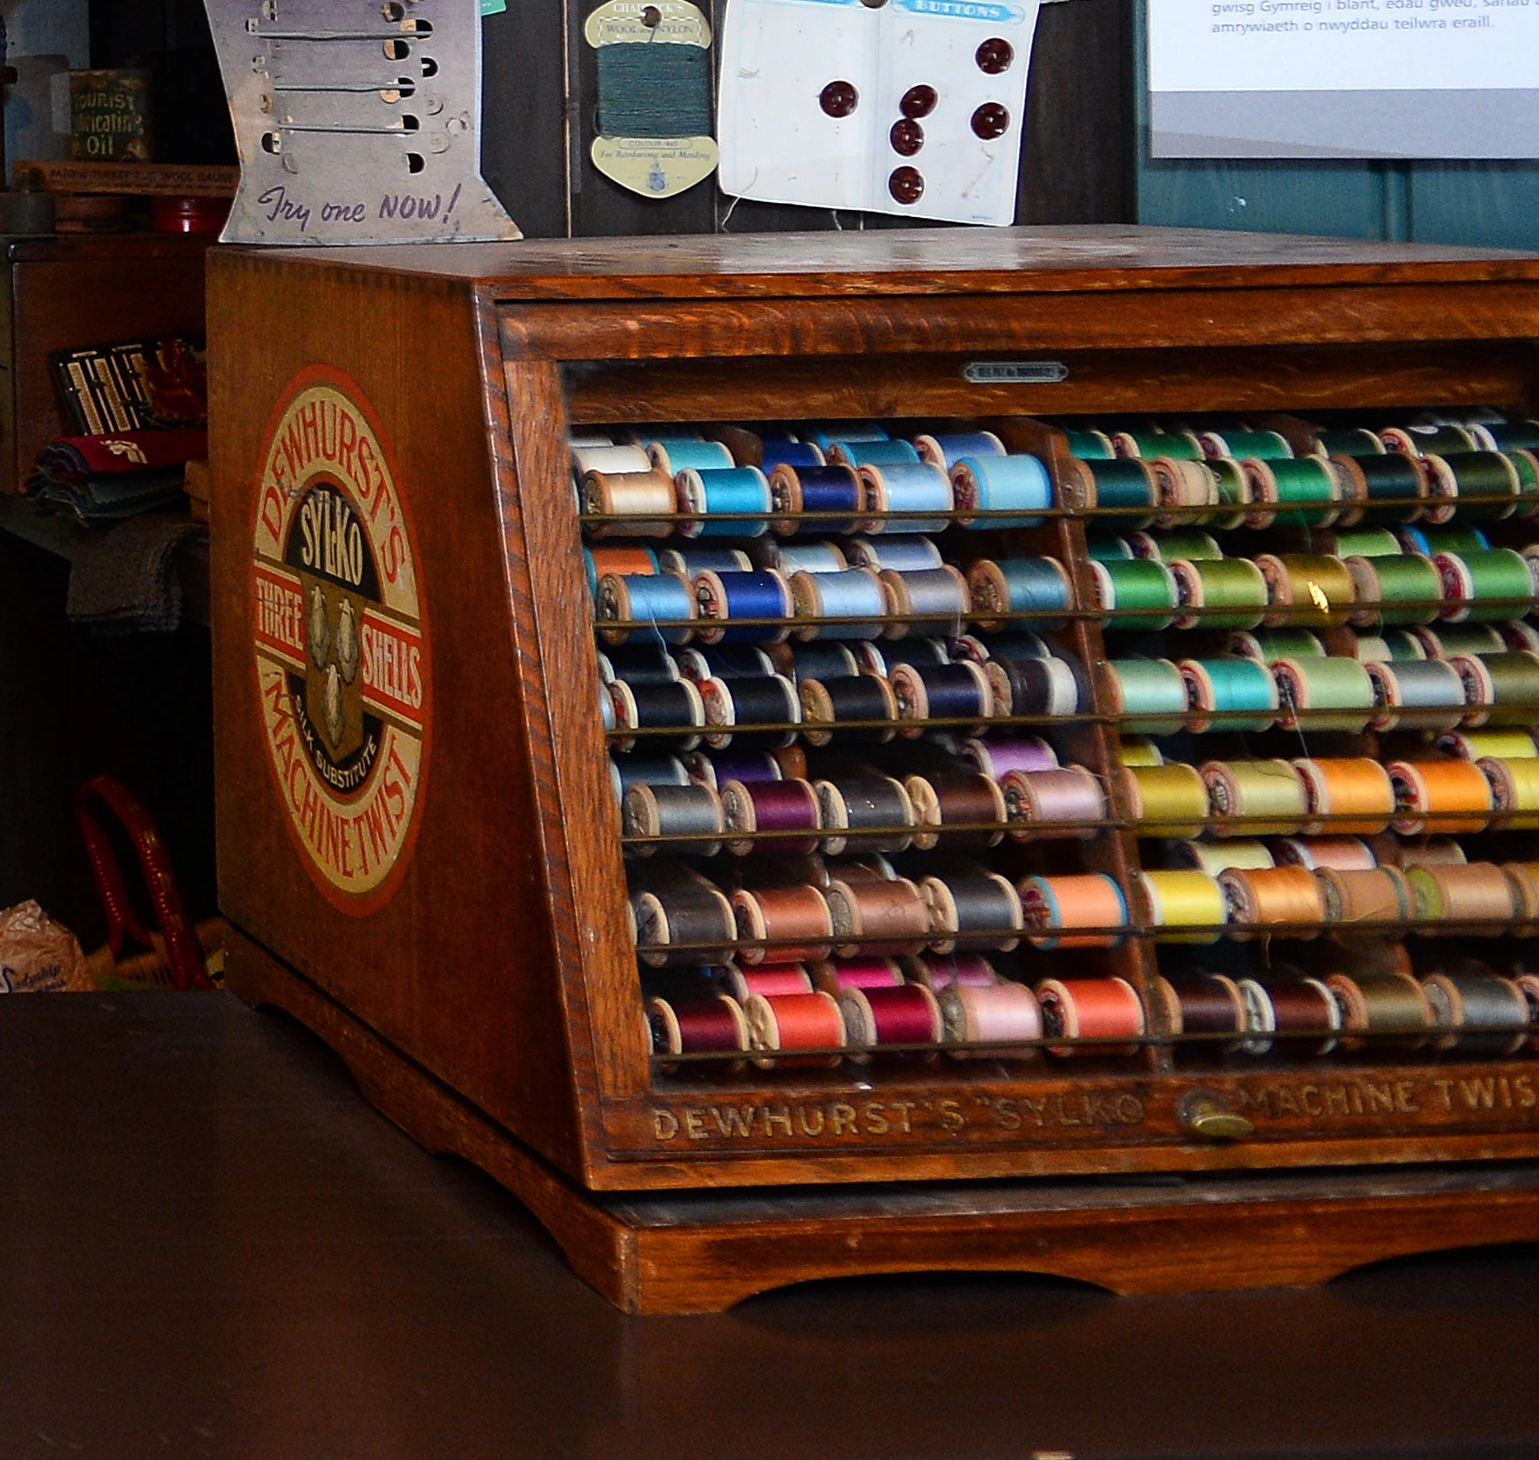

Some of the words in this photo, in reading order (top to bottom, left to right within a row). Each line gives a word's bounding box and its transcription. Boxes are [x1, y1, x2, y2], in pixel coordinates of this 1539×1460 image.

[606, 24, 637, 34] WOOL
[657, 24, 694, 34] NYLON
[914, 0, 1001, 20] BUTTONS
[1212, 17, 1299, 37] amrywiaeth
[1304, 21, 1313, 31] o
[1318, 16, 1389, 35] nwyddau
[1394, 15, 1447, 30] teilwra
[1452, 14, 1494, 29] eraill.
[86, 134, 115, 155] Oil
[257, 185, 311, 233] Try
[321, 197, 367, 224] one
[378, 182, 463, 225] NOW!
[261, 398, 405, 586] DEWHURST'S
[299, 488, 364, 587] SYLKO
[256, 574, 304, 652] THREE
[361, 615, 422, 712] SHELLS
[314, 733, 379, 790] SUBSTITUTE
[651, 1098, 966, 1142] DEWHURST'S
[1433, 1075, 1538, 1111] TWIS
